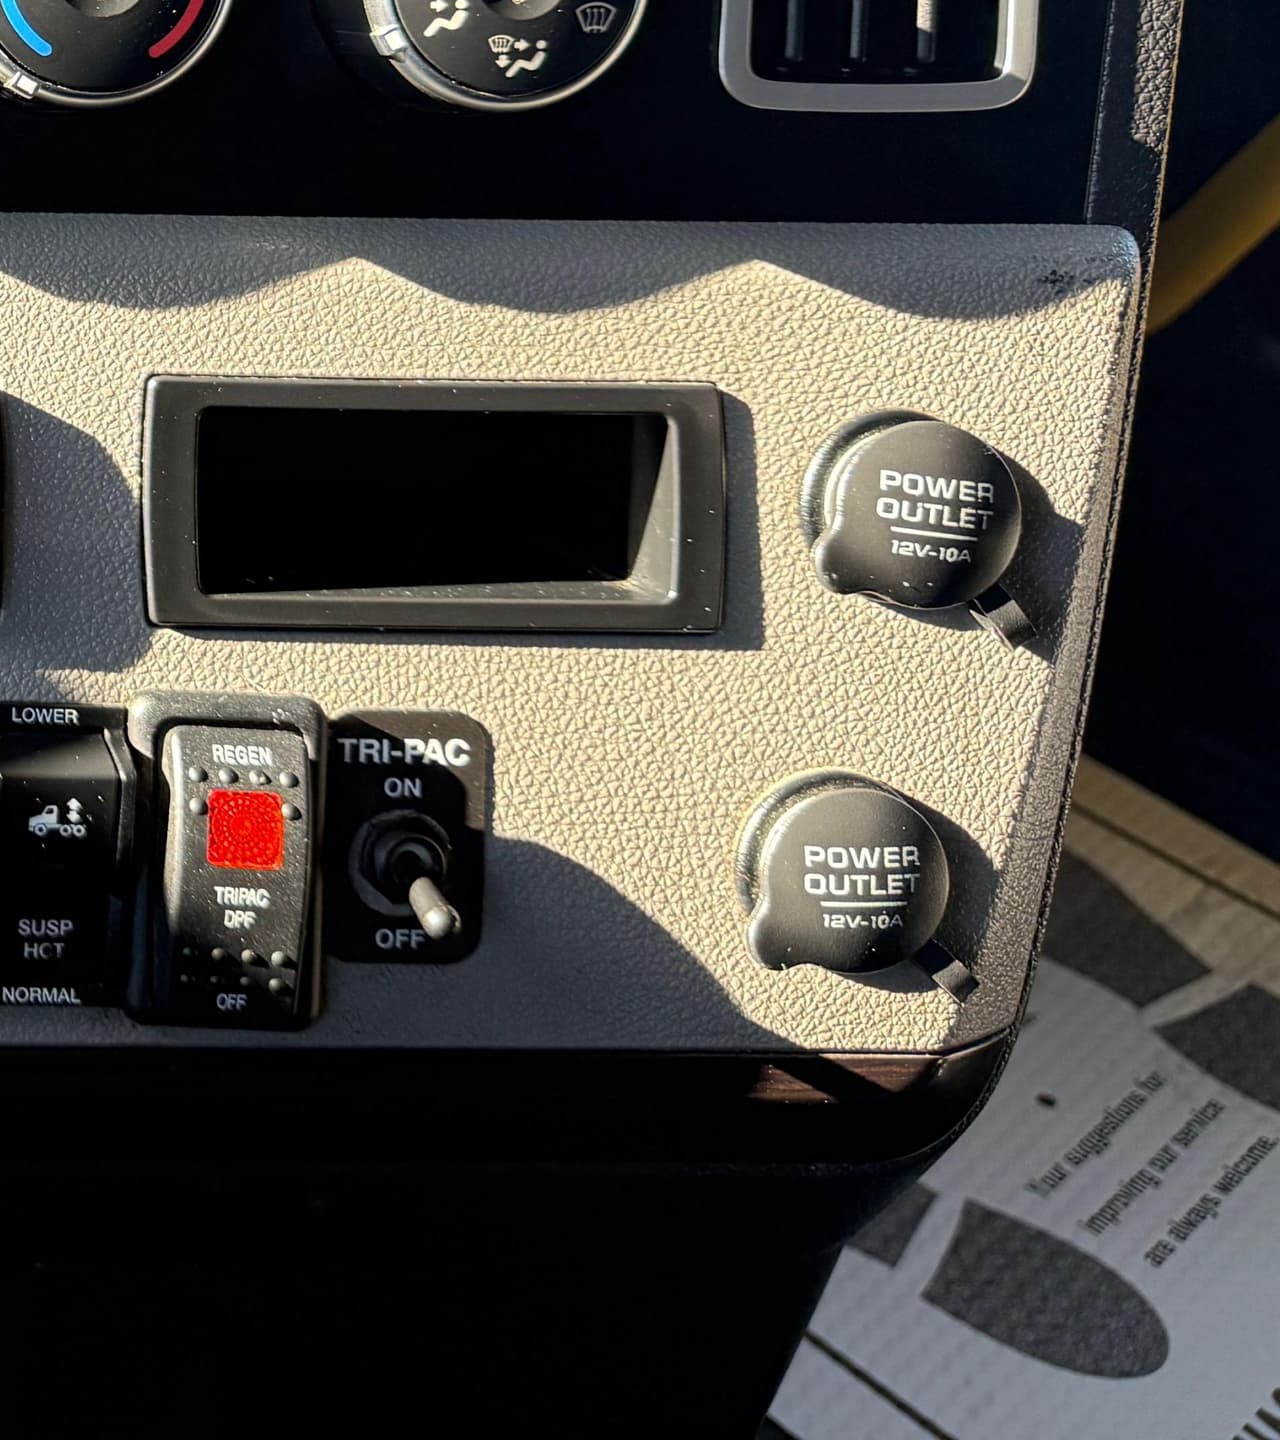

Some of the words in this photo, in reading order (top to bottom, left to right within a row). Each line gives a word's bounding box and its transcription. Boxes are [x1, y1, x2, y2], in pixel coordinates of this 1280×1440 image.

[878, 469, 995, 504] POWER
[876, 497, 994, 530] OUTLET
[890, 539, 972, 563] 12V-10A
[11, 706, 80, 725] LOWER
[211, 743, 273, 766] REGEN
[337, 737, 472, 767] TRI-PAC
[383, 777, 423, 798] ON
[803, 845, 921, 869] POWER
[803, 873, 921, 896] OUTLET
[214, 885, 270, 907] TRIPAC
[17, 919, 74, 937] SUSP
[223, 909, 257, 929] DPF
[822, 913, 903, 929] 12V-10A
[375, 928, 426, 949] OFF
[2, 986, 81, 1004] NORMAL
[216, 993, 247, 1010] OFF
